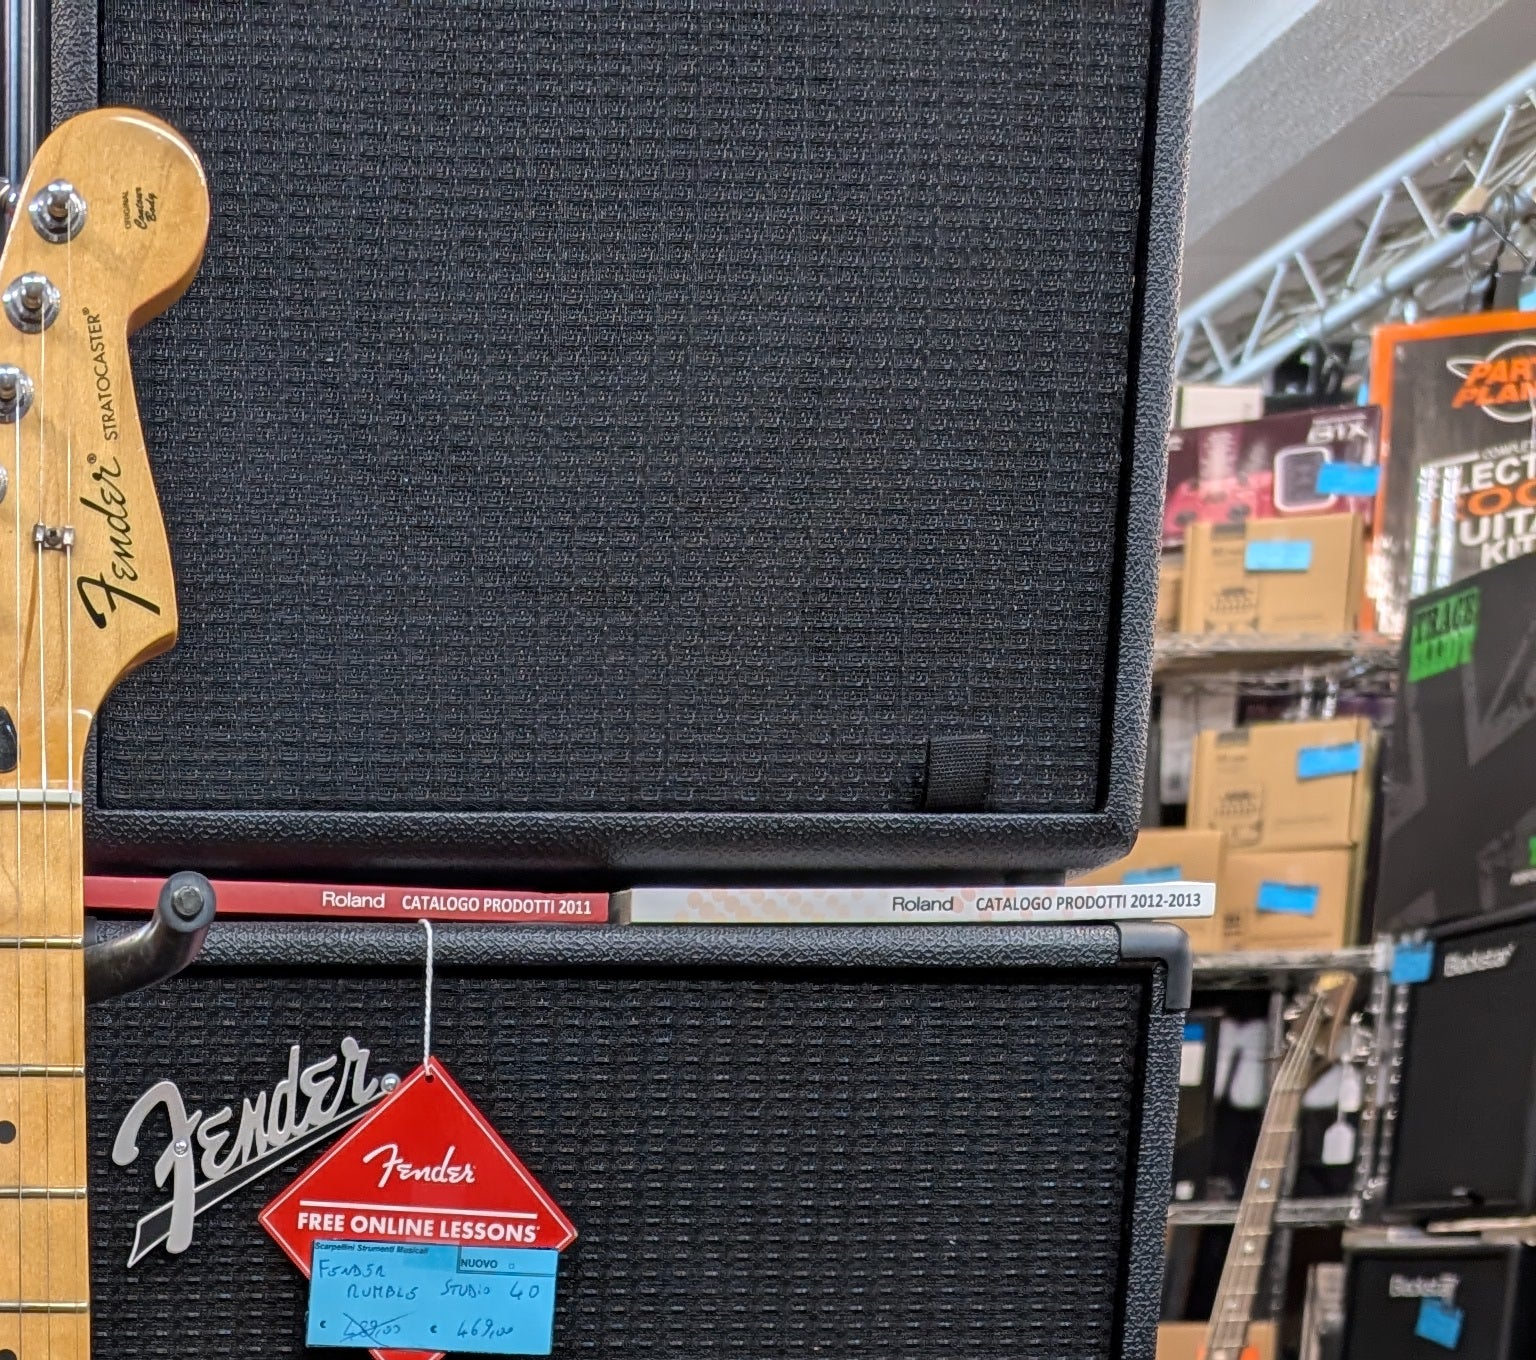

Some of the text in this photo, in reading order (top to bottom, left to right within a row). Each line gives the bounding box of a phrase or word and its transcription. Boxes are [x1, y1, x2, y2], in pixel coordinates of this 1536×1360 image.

[86, 312, 118, 441] STRATOCASTER
[76, 456, 161, 630] Fender
[321, 890, 592, 915] Roland CATALOGO PRODOTTI 2011
[892, 892, 1202, 913] Roland CATALOGO PRODOTTI 2012-2013
[112, 1036, 379, 1254] Fender
[362, 1143, 476, 1188] Fender
[297, 1211, 538, 1243] FREE ONLINE LESSONS
[314, 1241, 355, 1252] Scarpellini
[356, 1243, 396, 1254] Strumenti
[460, 1258, 499, 1269] NUOVO
